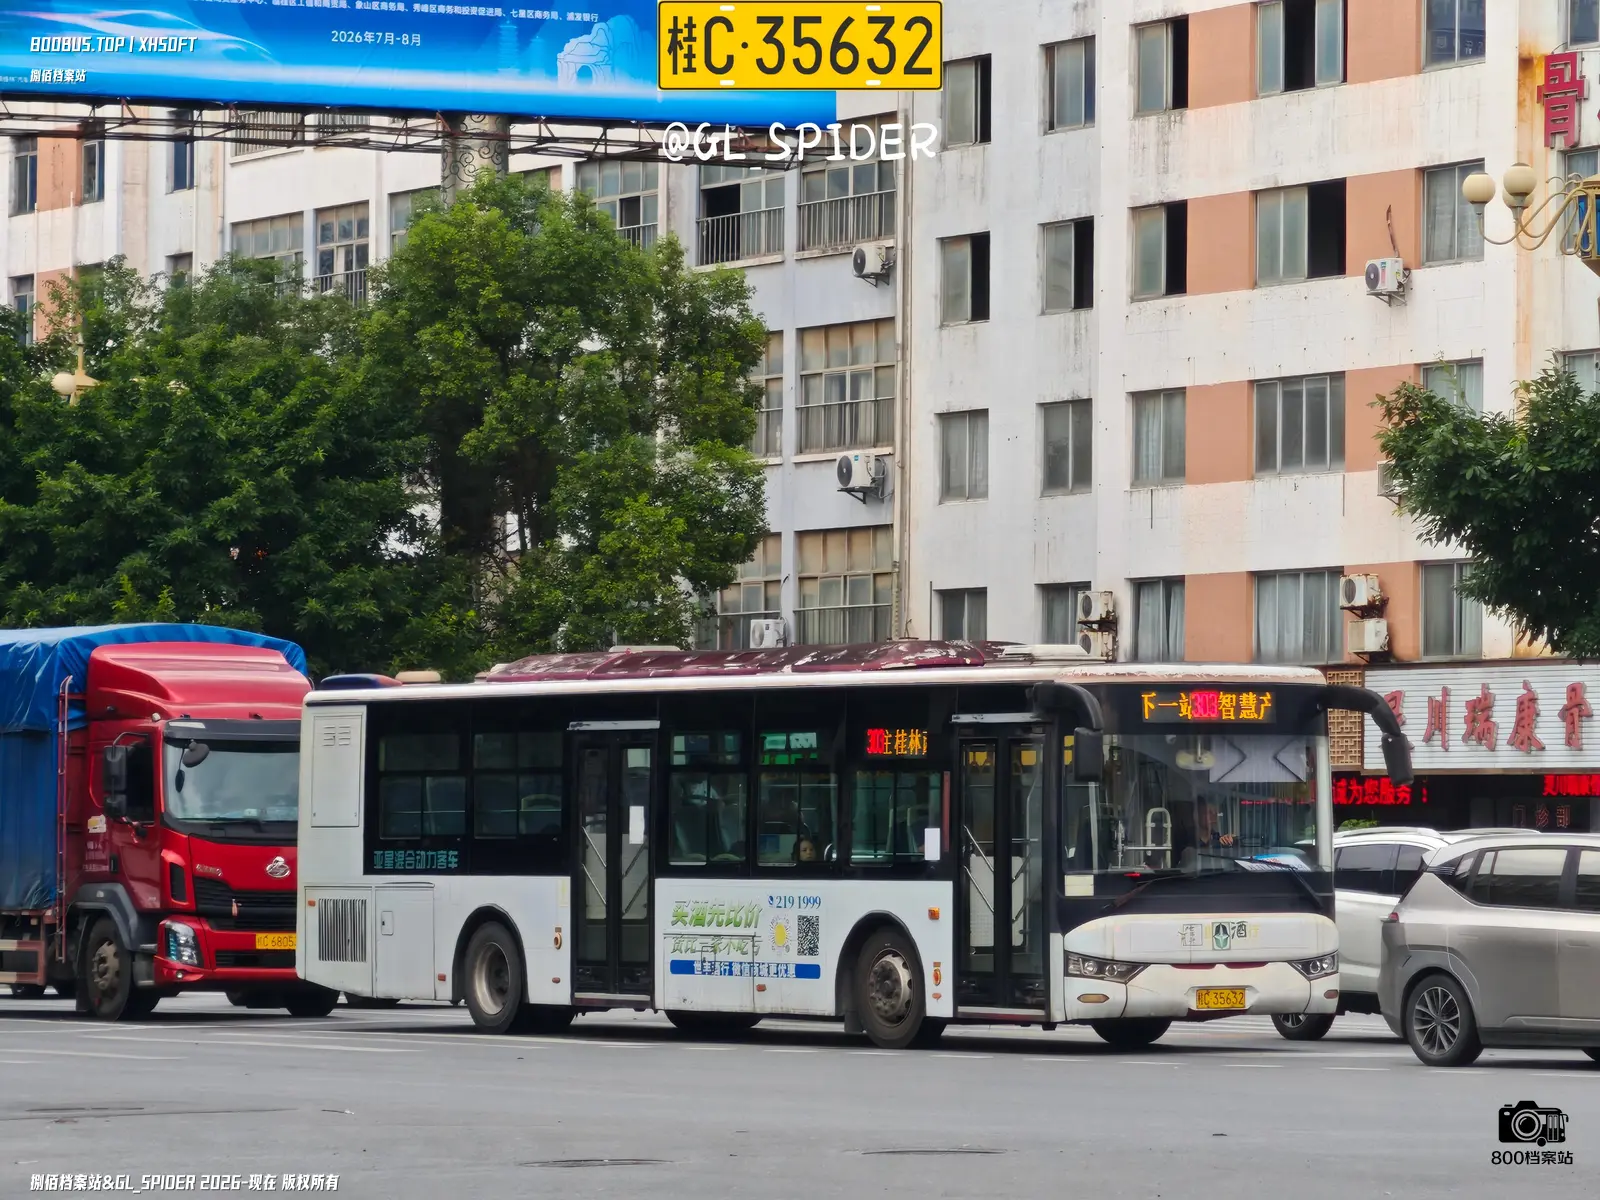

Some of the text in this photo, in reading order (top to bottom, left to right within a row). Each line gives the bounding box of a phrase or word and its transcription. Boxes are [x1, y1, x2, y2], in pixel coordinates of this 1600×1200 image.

[331, 30, 421, 46] 2026年7月-8月
[1537, 51, 1586, 149] 骨
[1512, 804, 1571, 829] 门诊部
[671, 900, 763, 929] 买酒先比价
[775, 895, 822, 909] 219 1999
